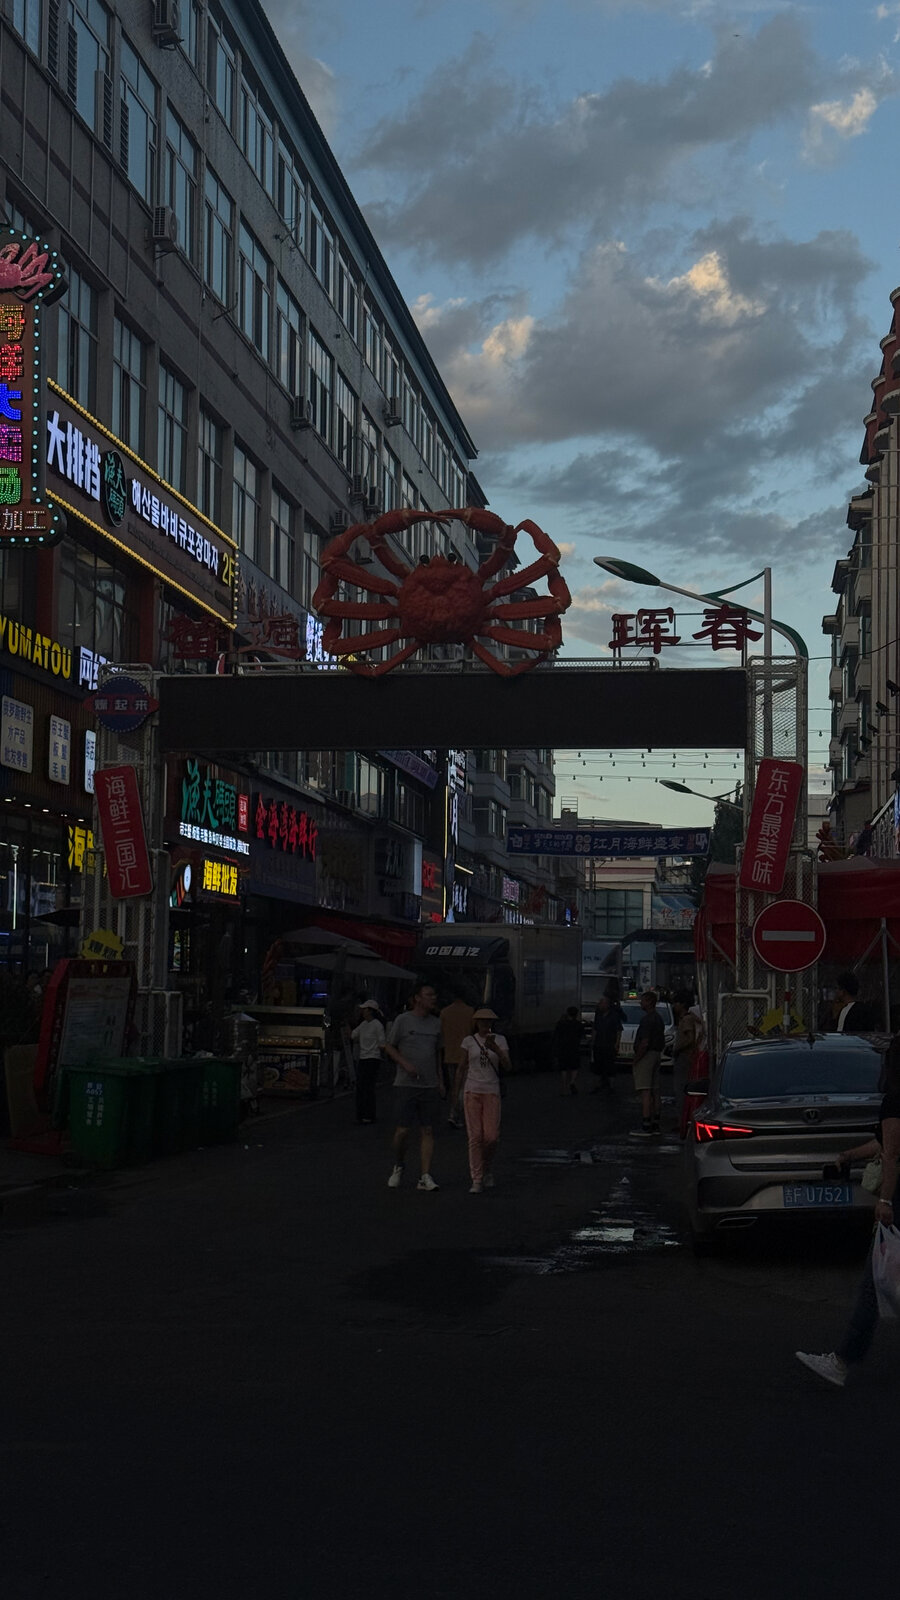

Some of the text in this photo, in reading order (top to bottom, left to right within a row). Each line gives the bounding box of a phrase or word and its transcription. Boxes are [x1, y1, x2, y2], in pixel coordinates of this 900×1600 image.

[46, 410, 102, 502] 大排档
[0, 508, 47, 531] 加工
[221, 552, 235, 587] 2F
[608, 604, 764, 654] 珲春
[105, 775, 140, 890] 海鲜三国汇
[593, 836, 684, 851] 江月海鲜盛宴
[752, 768, 791, 885] 东方最美味
[202, 859, 238, 896] 海鲜批发
[426, 945, 481, 957] 中国重汽
[806, 1186, 850, 1203] U7521
